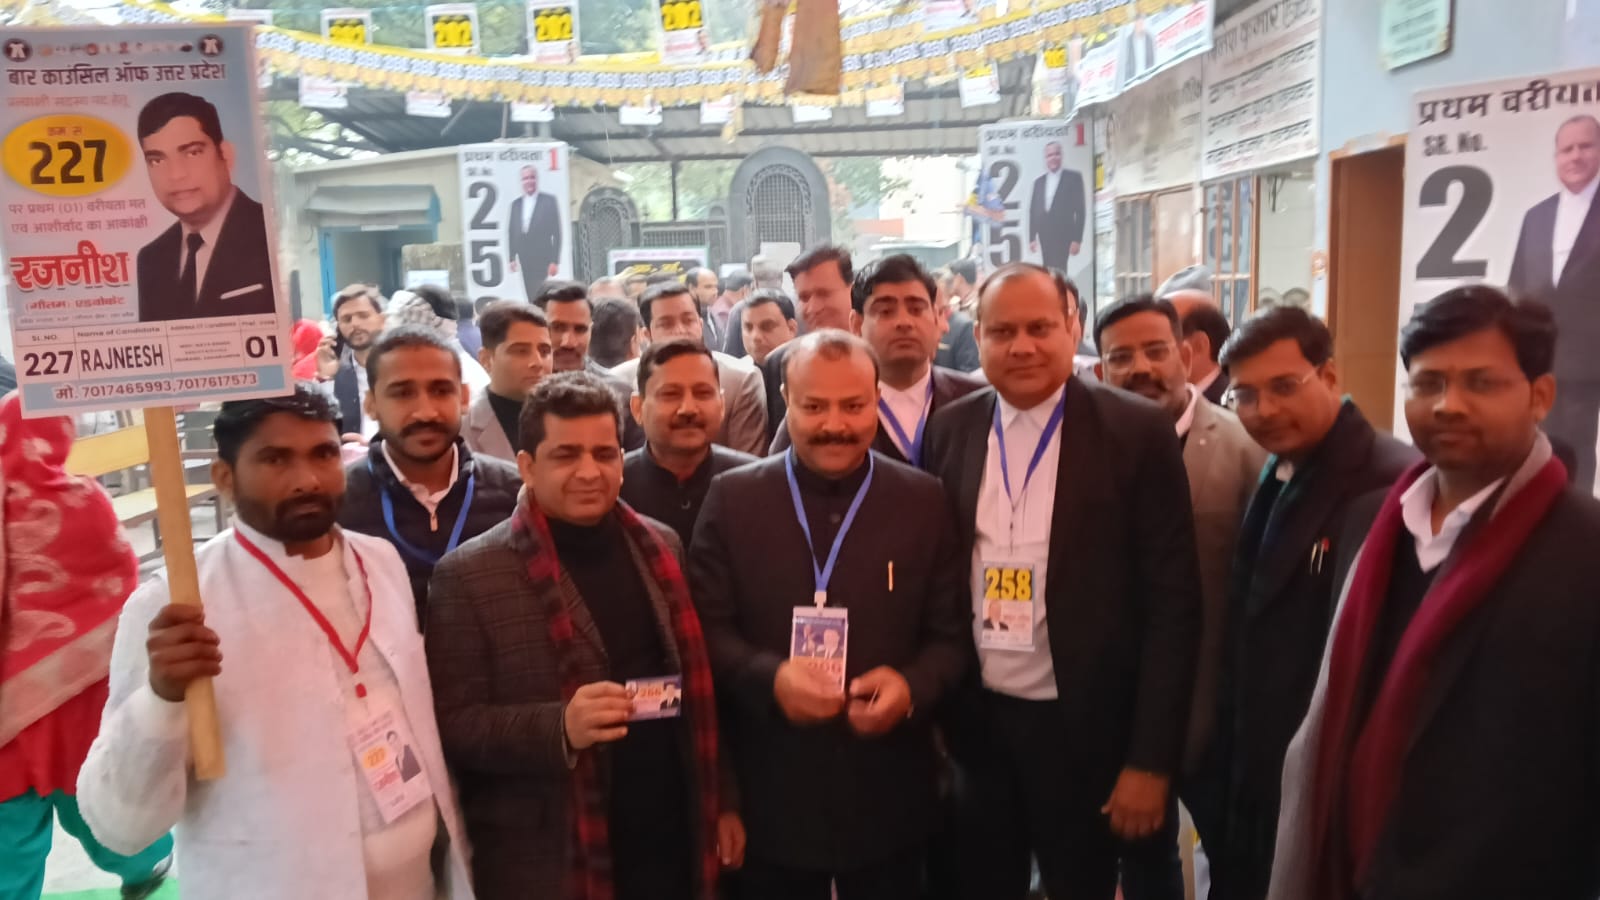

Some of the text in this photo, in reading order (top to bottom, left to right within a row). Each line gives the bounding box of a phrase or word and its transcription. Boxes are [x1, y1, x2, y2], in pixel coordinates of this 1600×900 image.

[7, 60, 226, 85] बार काउंसिल ऑफ उत्तर प्रदेश
[1419, 92, 1493, 125] प्रथम
[1075, 123, 1085, 146] 1
[29, 139, 107, 185] 227
[549, 147, 560, 171] 1
[9, 204, 24, 214] पर
[27, 203, 55, 214] प्रथम
[128, 198, 146, 209] मत
[87, 219, 102, 231] का
[10, 240, 129, 290] रजनीश
[81, 344, 164, 372] RAJNEESH
[245, 335, 279, 359] 01
[23, 350, 74, 377] 227
[55, 384, 79, 400] मो.
[985, 567, 1031, 601] 258
